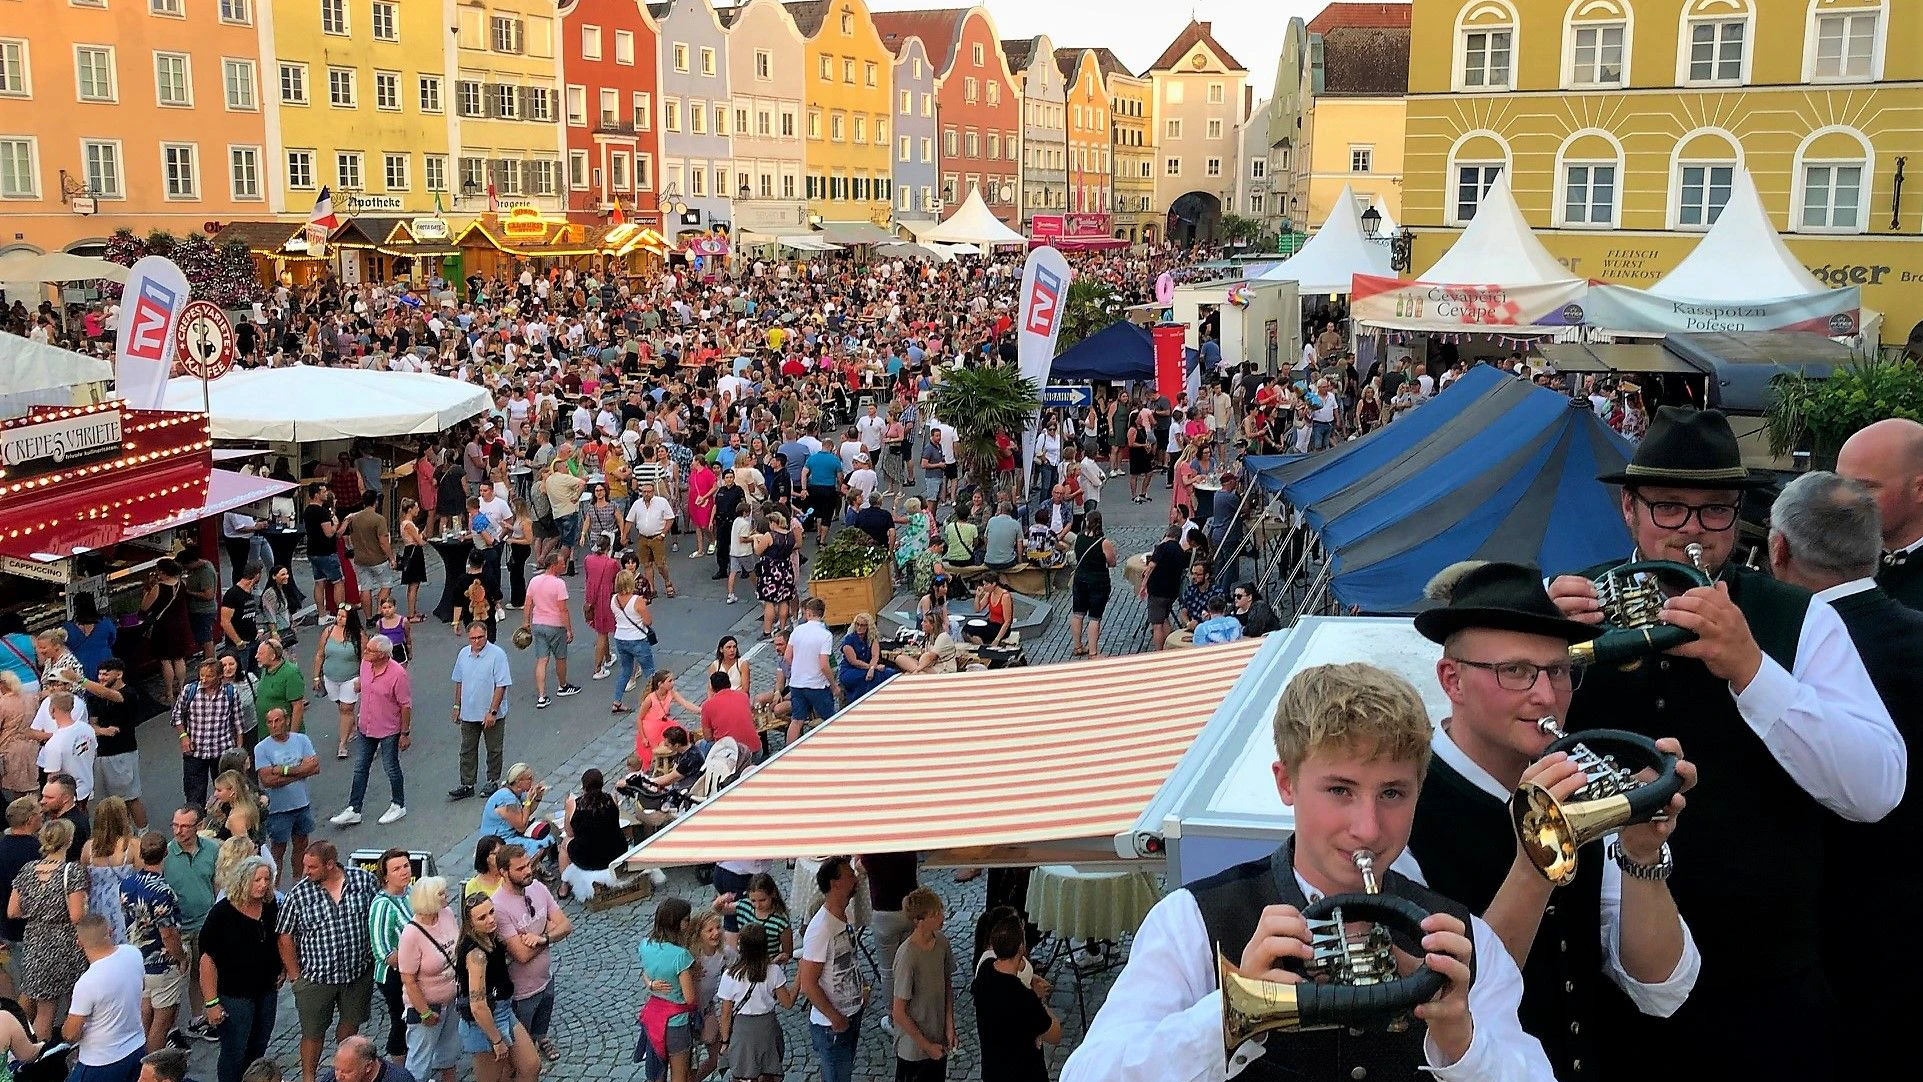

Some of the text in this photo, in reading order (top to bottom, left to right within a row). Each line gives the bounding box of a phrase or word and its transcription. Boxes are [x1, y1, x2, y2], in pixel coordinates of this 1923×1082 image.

[347, 196, 401, 209] Apotheke
[1603, 259, 1646, 269] WURST
[1607, 250, 1659, 259] FLEISCH
[1601, 269, 1664, 280] FEINKOST
[1030, 270, 1059, 329] TV1
[132, 282, 171, 353] TV1
[201, 304, 231, 347] VARIETE
[184, 356, 226, 378] KAFEE
[66, 421, 121, 451] VARIETE
[8, 559, 63, 578] CAPPUCCINO
